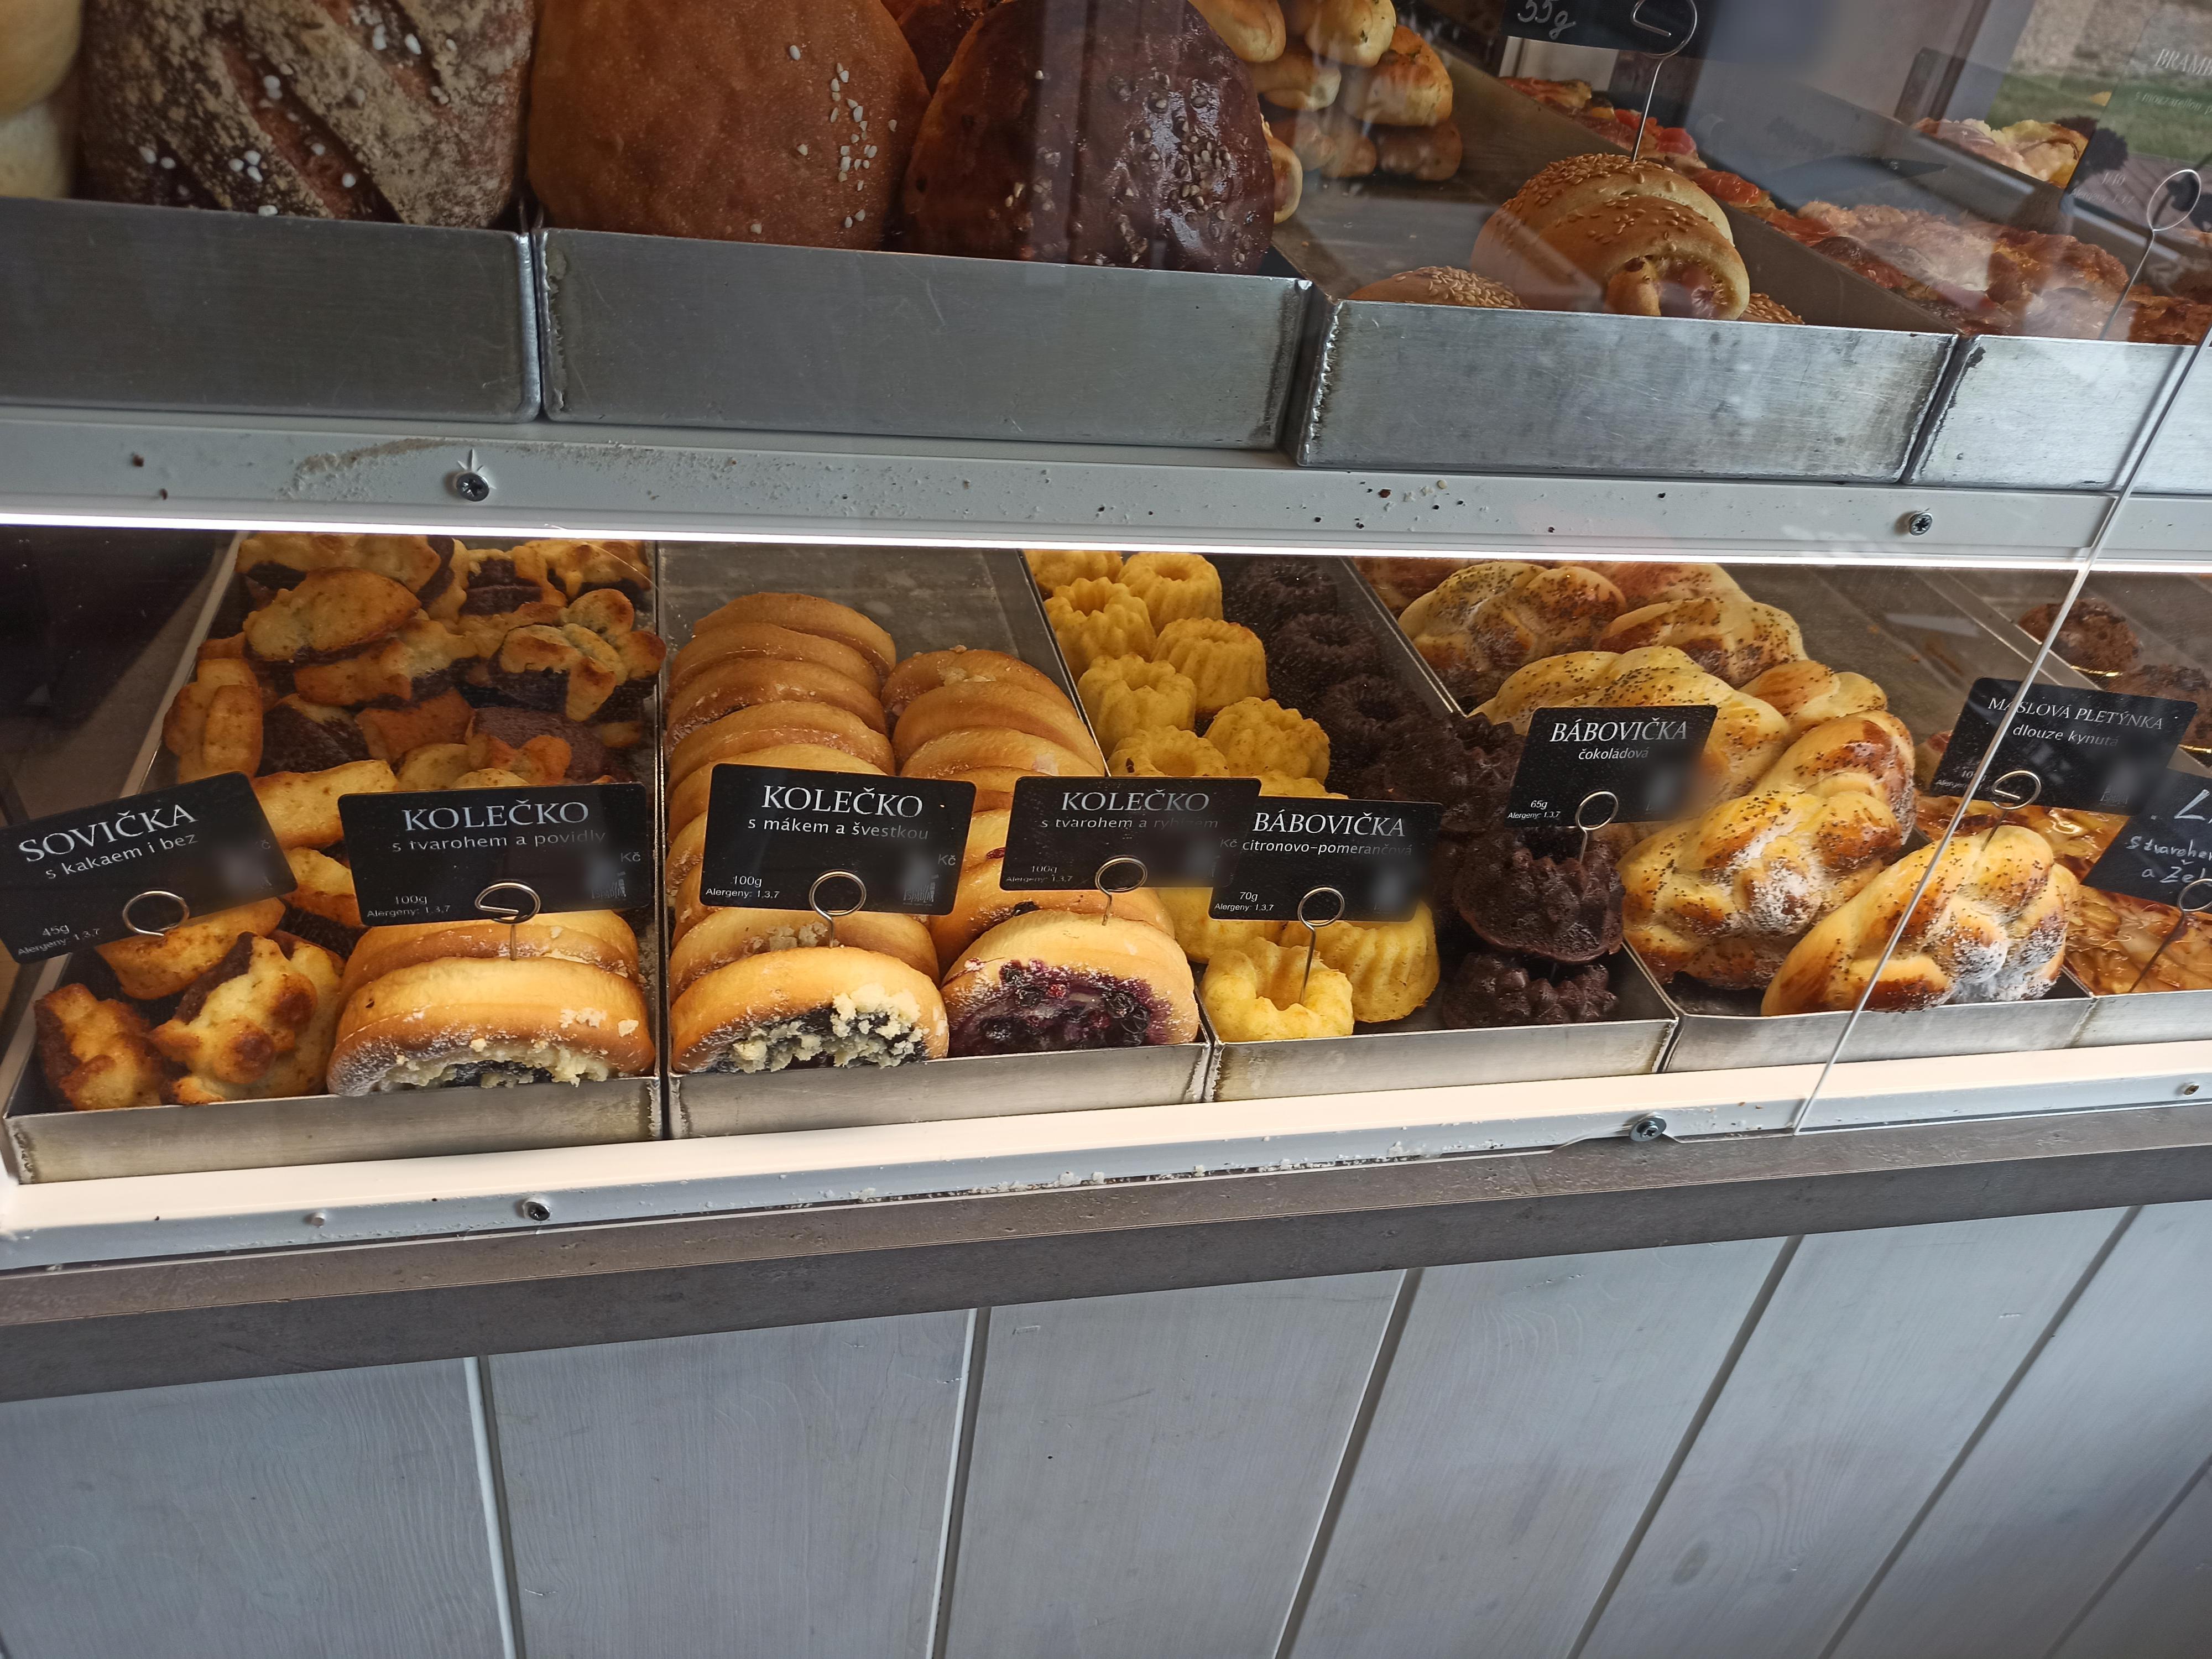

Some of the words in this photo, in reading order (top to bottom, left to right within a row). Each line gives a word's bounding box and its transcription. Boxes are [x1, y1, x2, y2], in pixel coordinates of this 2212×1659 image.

[2074, 708, 2163, 729] PLETÝNKA
[1550, 717, 1687, 742] BÁBOVIČKA
[2013, 724, 2063, 740] dlouze
[2068, 730, 2120, 746] kynutá
[1578, 747, 1650, 760] čokoládová
[761, 785, 924, 818] KOLEČKO
[1061, 789, 1209, 811] KOLEČKO
[1531, 800, 1548, 810] 65g
[401, 799, 589, 831] KOLEČKO
[1041, 819, 1048, 828] s
[1056, 818, 1133, 828] tvarohem
[1252, 808, 1406, 837] BÁBOVIČKA
[19, 804, 199, 863] SOVIČKA
[748, 818, 756, 829] s
[764, 816, 829, 834] mákem
[836, 823, 846, 835] a
[852, 822, 929, 840] švestkou
[392, 841, 402, 852] s
[410, 835, 508, 851] tvarohem
[516, 834, 527, 846] a
[535, 830, 606, 848] povidly
[1220, 839, 1238, 848] Kč
[45, 869, 57, 879] s
[62, 846, 143, 876] kakaem
[148, 838, 155, 853] i
[159, 833, 199, 851] bez
[620, 852, 641, 862] Kč
[938, 854, 956, 866] Kč
[734, 875, 762, 888] 100g
[396, 895, 427, 905] 100g
[1239, 891, 1258, 902] 70g
[42, 925, 70, 936] 45g
